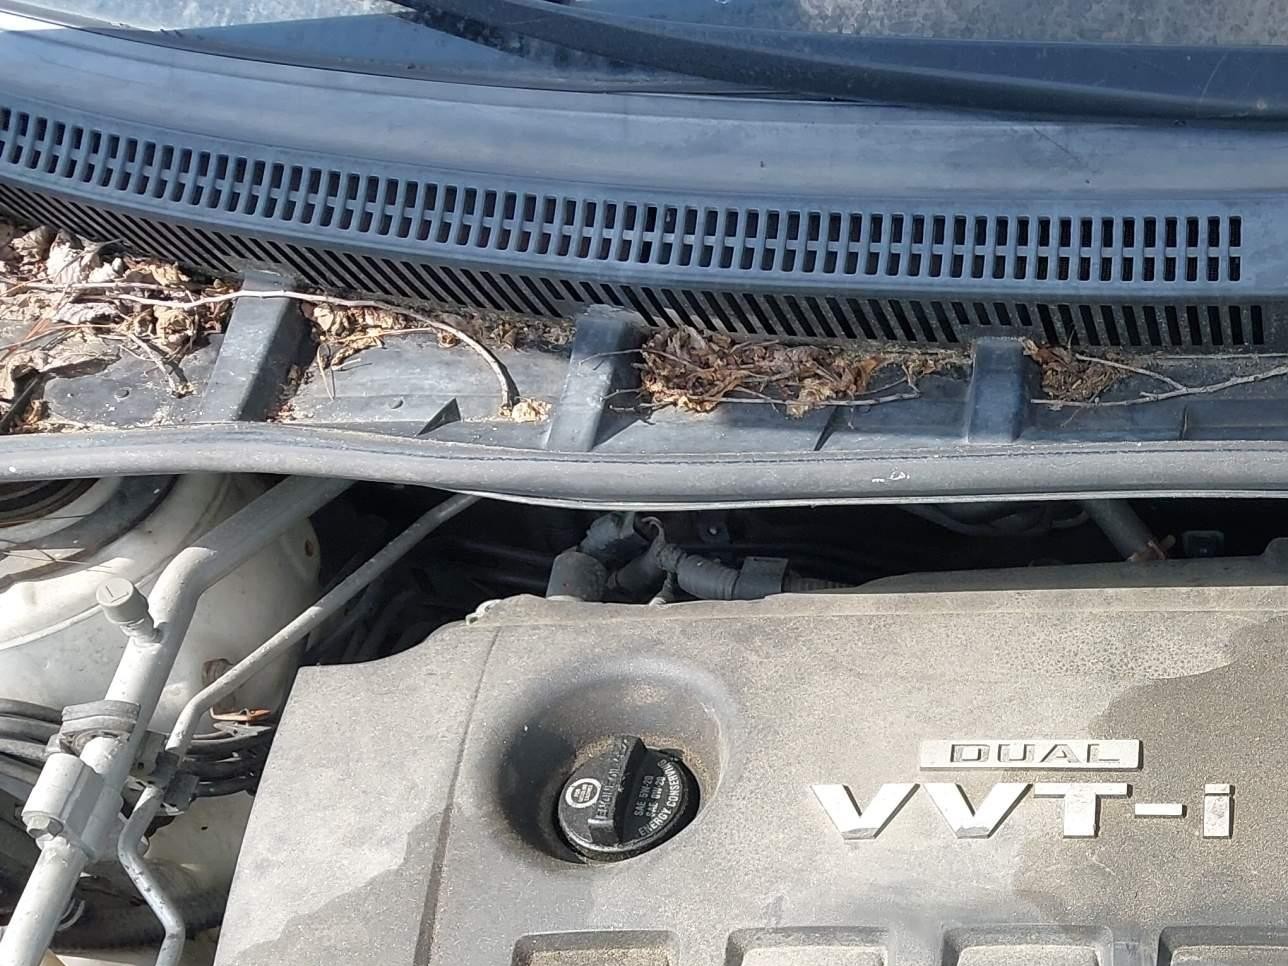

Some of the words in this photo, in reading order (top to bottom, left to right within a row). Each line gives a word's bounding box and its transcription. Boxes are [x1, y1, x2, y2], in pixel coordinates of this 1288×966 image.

[949, 743, 1122, 764] DUAL
[633, 798, 647, 817] SAE
[638, 807, 672, 837] ENERGY
[656, 759, 682, 808] CONSERVING
[809, 783, 1237, 840] VVT-i
